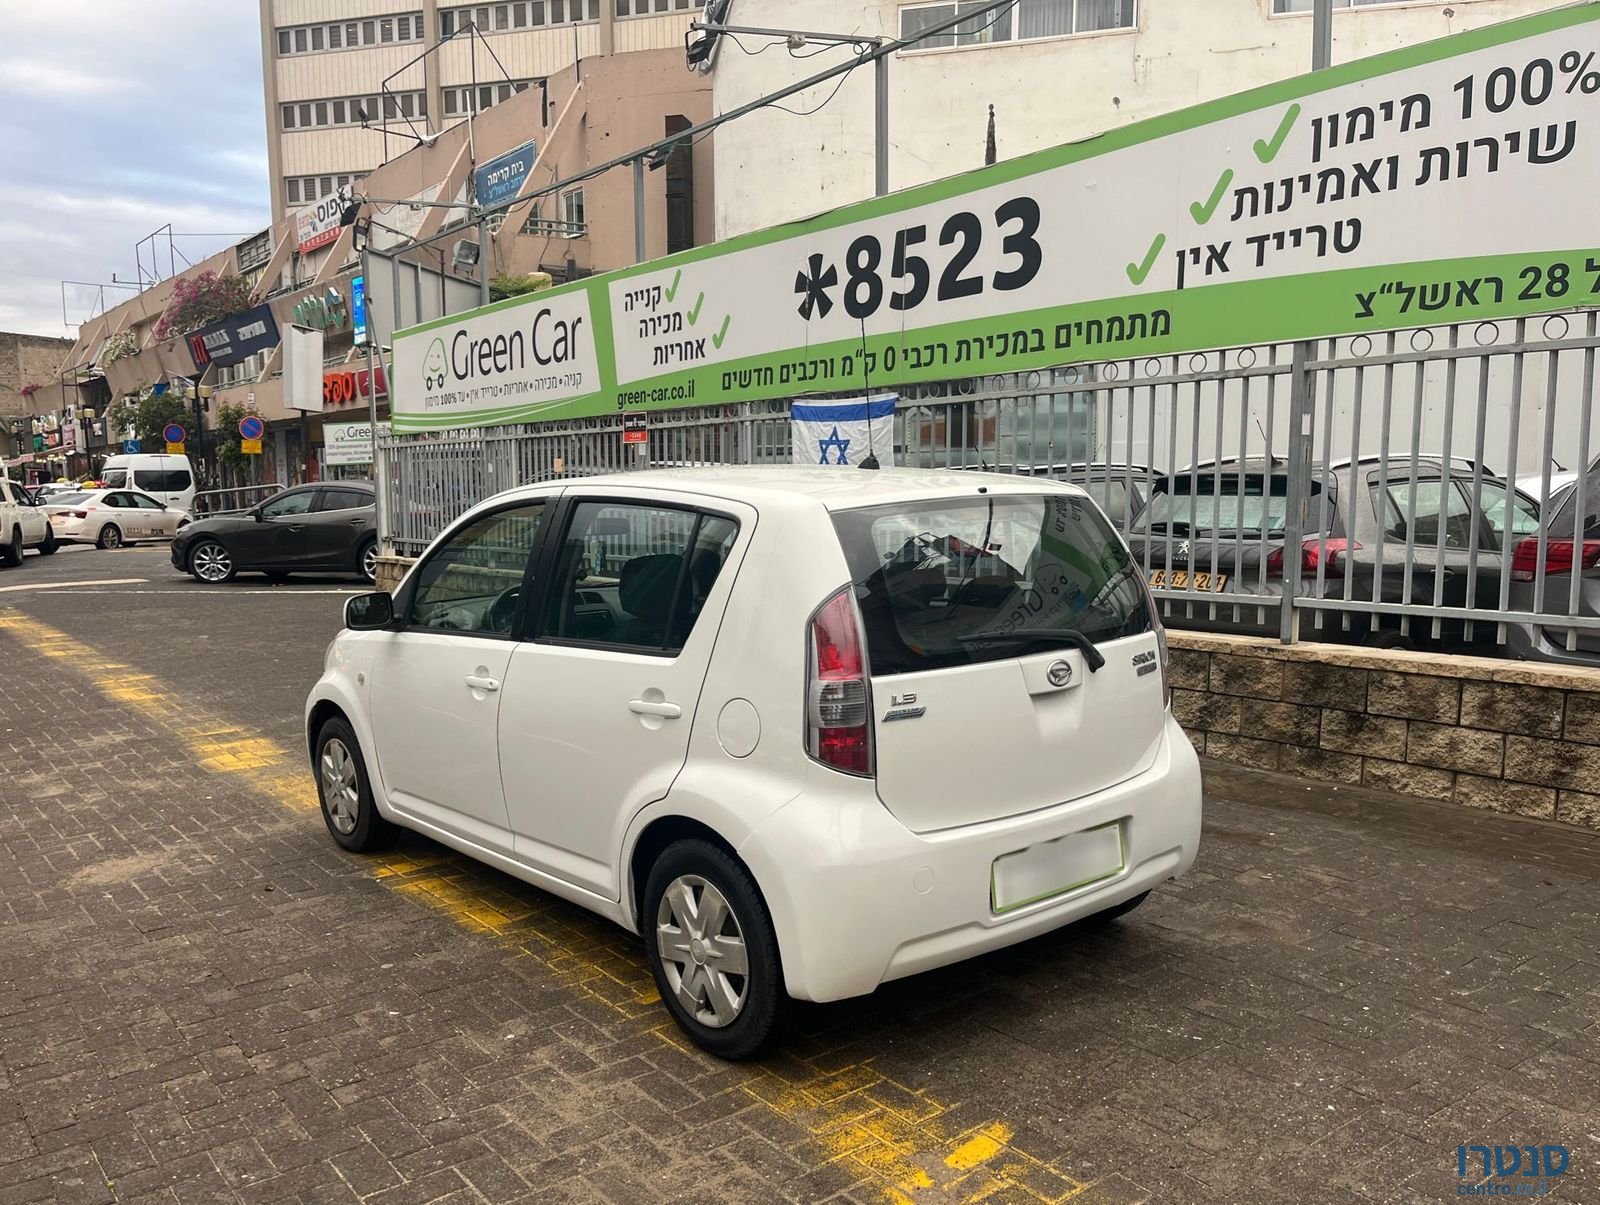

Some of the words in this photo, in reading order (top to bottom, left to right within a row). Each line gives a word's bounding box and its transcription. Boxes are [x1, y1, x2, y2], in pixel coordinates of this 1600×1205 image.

[1454, 50, 1600, 120] 100%
[1311, 92, 1431, 163] מימון
[1415, 120, 1577, 186] שירות
[1230, 154, 1399, 221] ואמינות
[1246, 217, 1362, 268] טרייד
[1175, 240, 1232, 290] אין
[1518, 263, 1569, 300] 28
[624, 285, 661, 312] קנייה
[639, 311, 682, 339] מכירה
[1055, 309, 1170, 350] מתמחים
[452, 329, 524, 380] Green
[532, 308, 582, 366] Car
[653, 338, 706, 366] אחריות
[902, 343, 948, 369] רכבי
[955, 328, 1045, 364] במכירת
[779, 357, 835, 384] ורכבים
[883, 346, 896, 372] 0
[481, 385, 498, 398] טרייד
[503, 381, 529, 396] אחריות
[534, 376, 558, 392] מכירה
[563, 372, 582, 390] קניה
[722, 366, 774, 391] חדשים
[441, 393, 457, 404] 100%
[457, 392, 465, 402] עד
[470, 389, 480, 404] אין
[617, 379, 695, 410] green-car.co.il
[891, 691, 916, 706] 1.3
